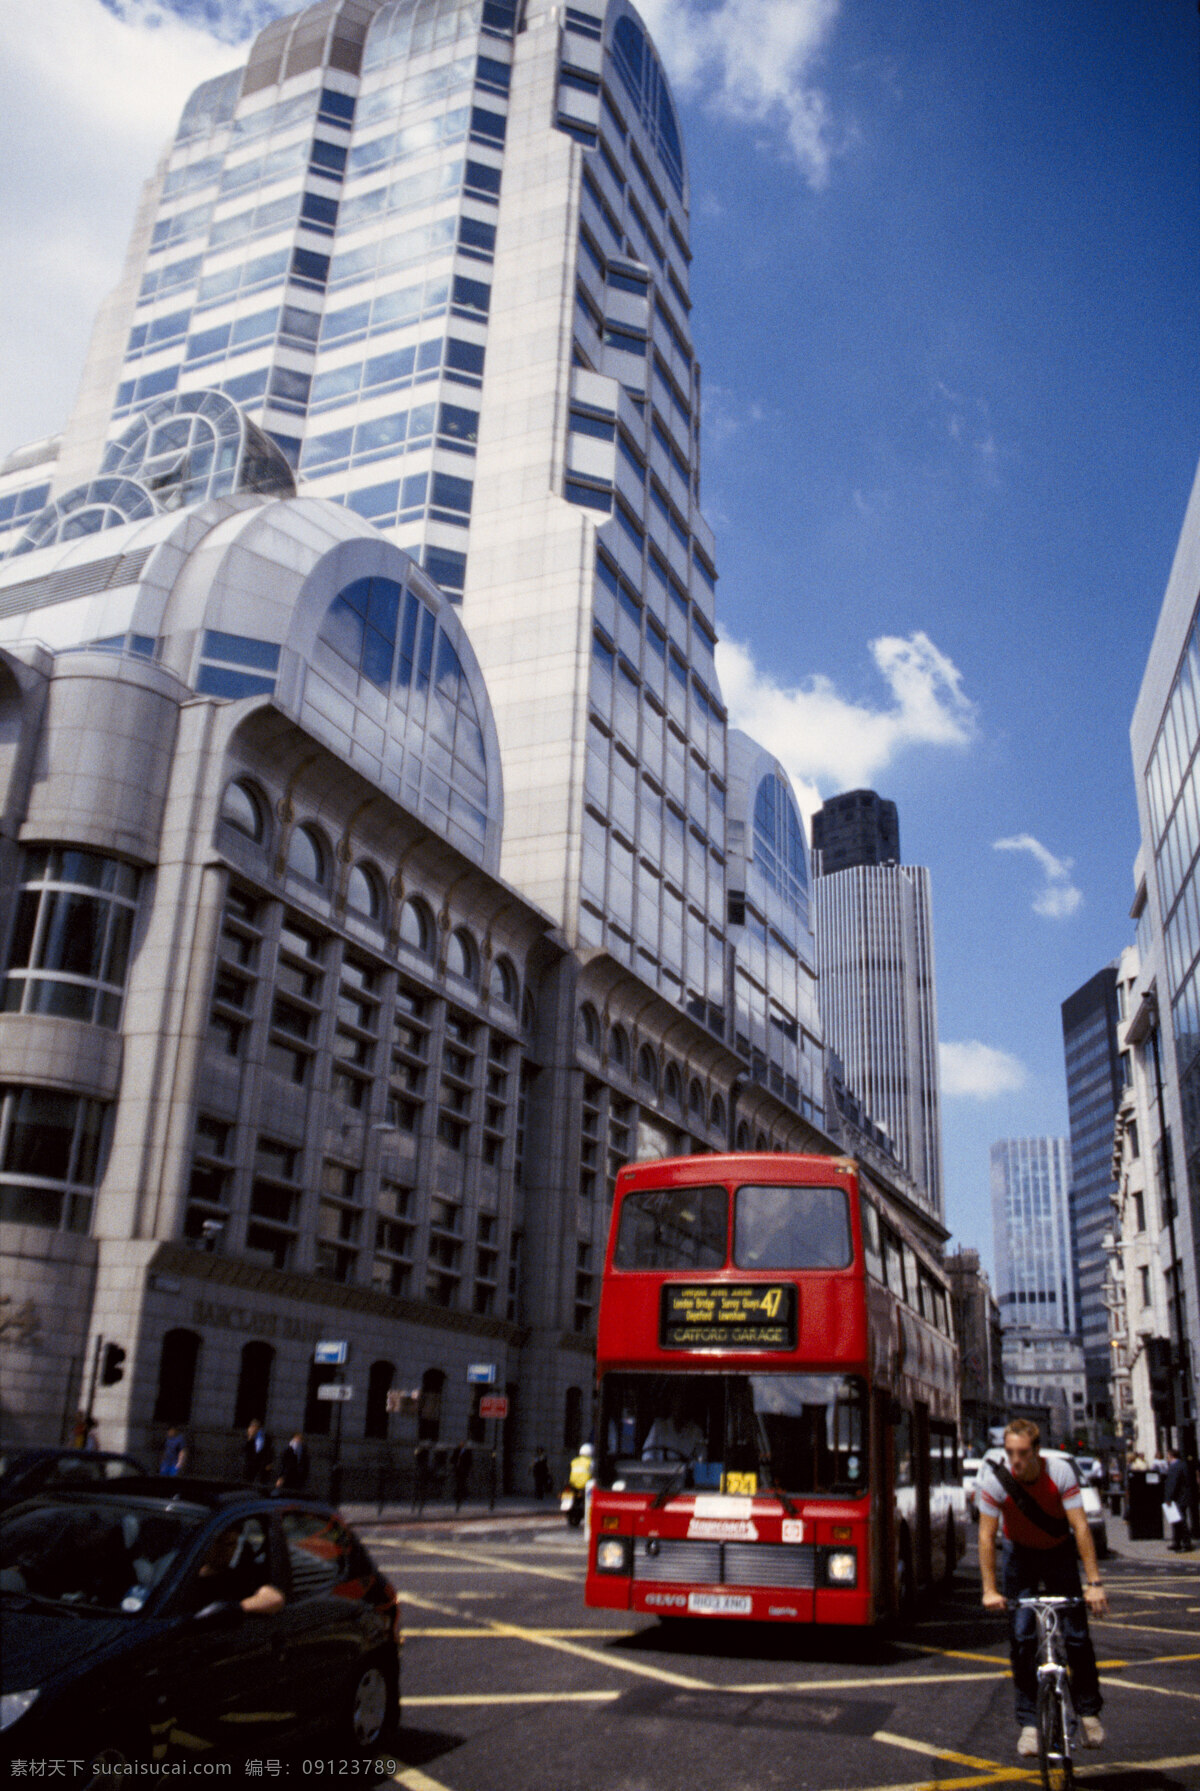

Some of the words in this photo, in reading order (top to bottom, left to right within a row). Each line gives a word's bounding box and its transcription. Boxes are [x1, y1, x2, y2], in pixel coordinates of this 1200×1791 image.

[673, 1298, 694, 1310] London
[696, 1298, 715, 1311] Bridge
[759, 1288, 782, 1318] 47
[674, 1328, 727, 1342] CATFORD
[732, 1328, 782, 1343] GARAGE
